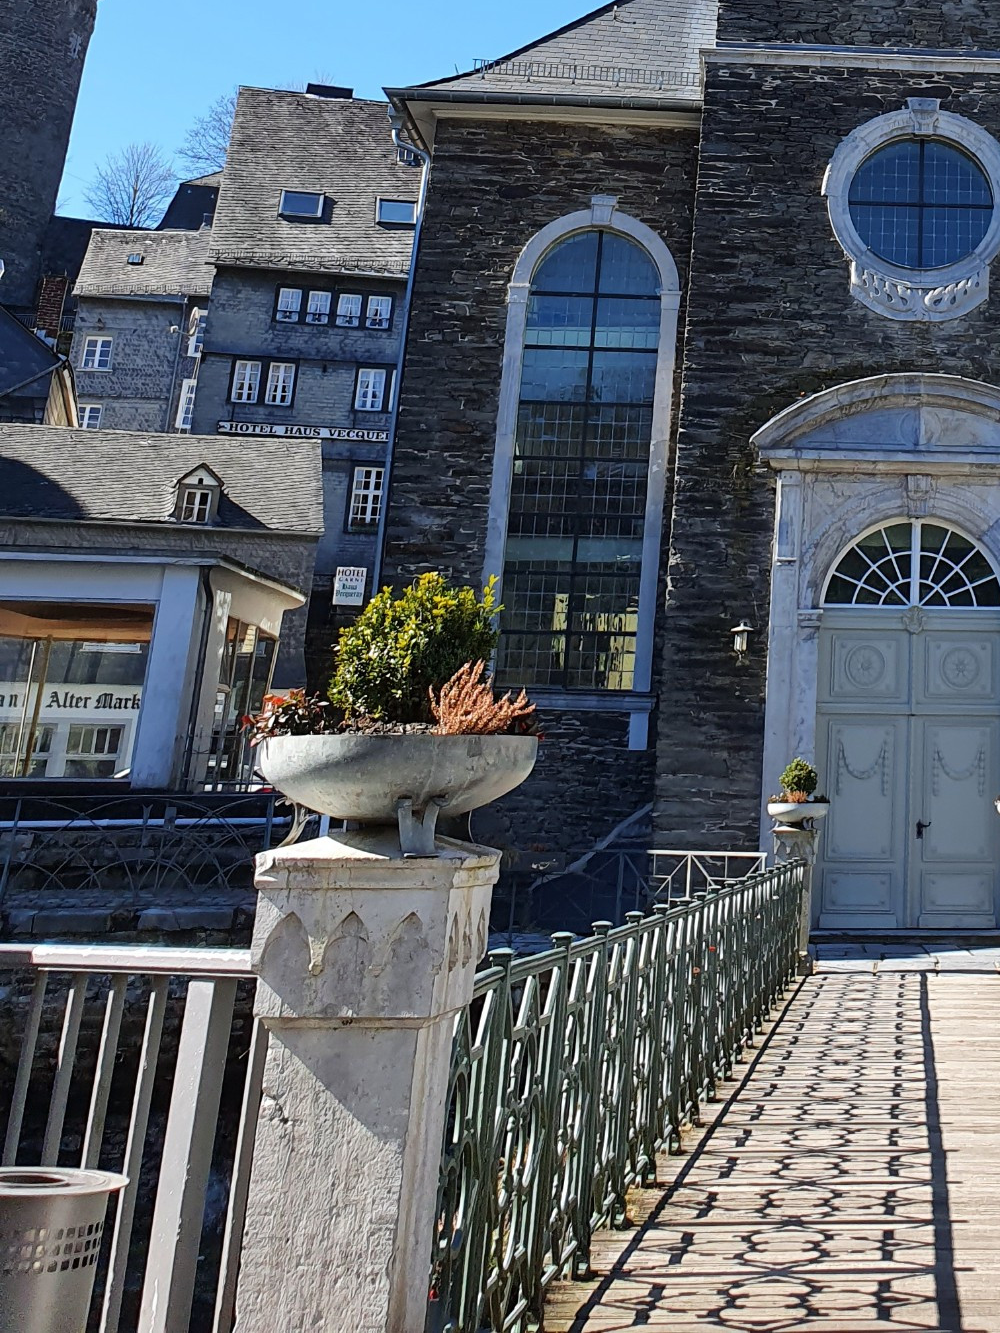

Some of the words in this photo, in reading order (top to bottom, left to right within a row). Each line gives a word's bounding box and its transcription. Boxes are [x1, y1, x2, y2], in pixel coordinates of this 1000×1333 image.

[229, 423, 277, 434] HOTEL
[284, 426, 321, 437] HAUS
[337, 568, 365, 578] HOTEL
[45, 691, 92, 709] Alter
